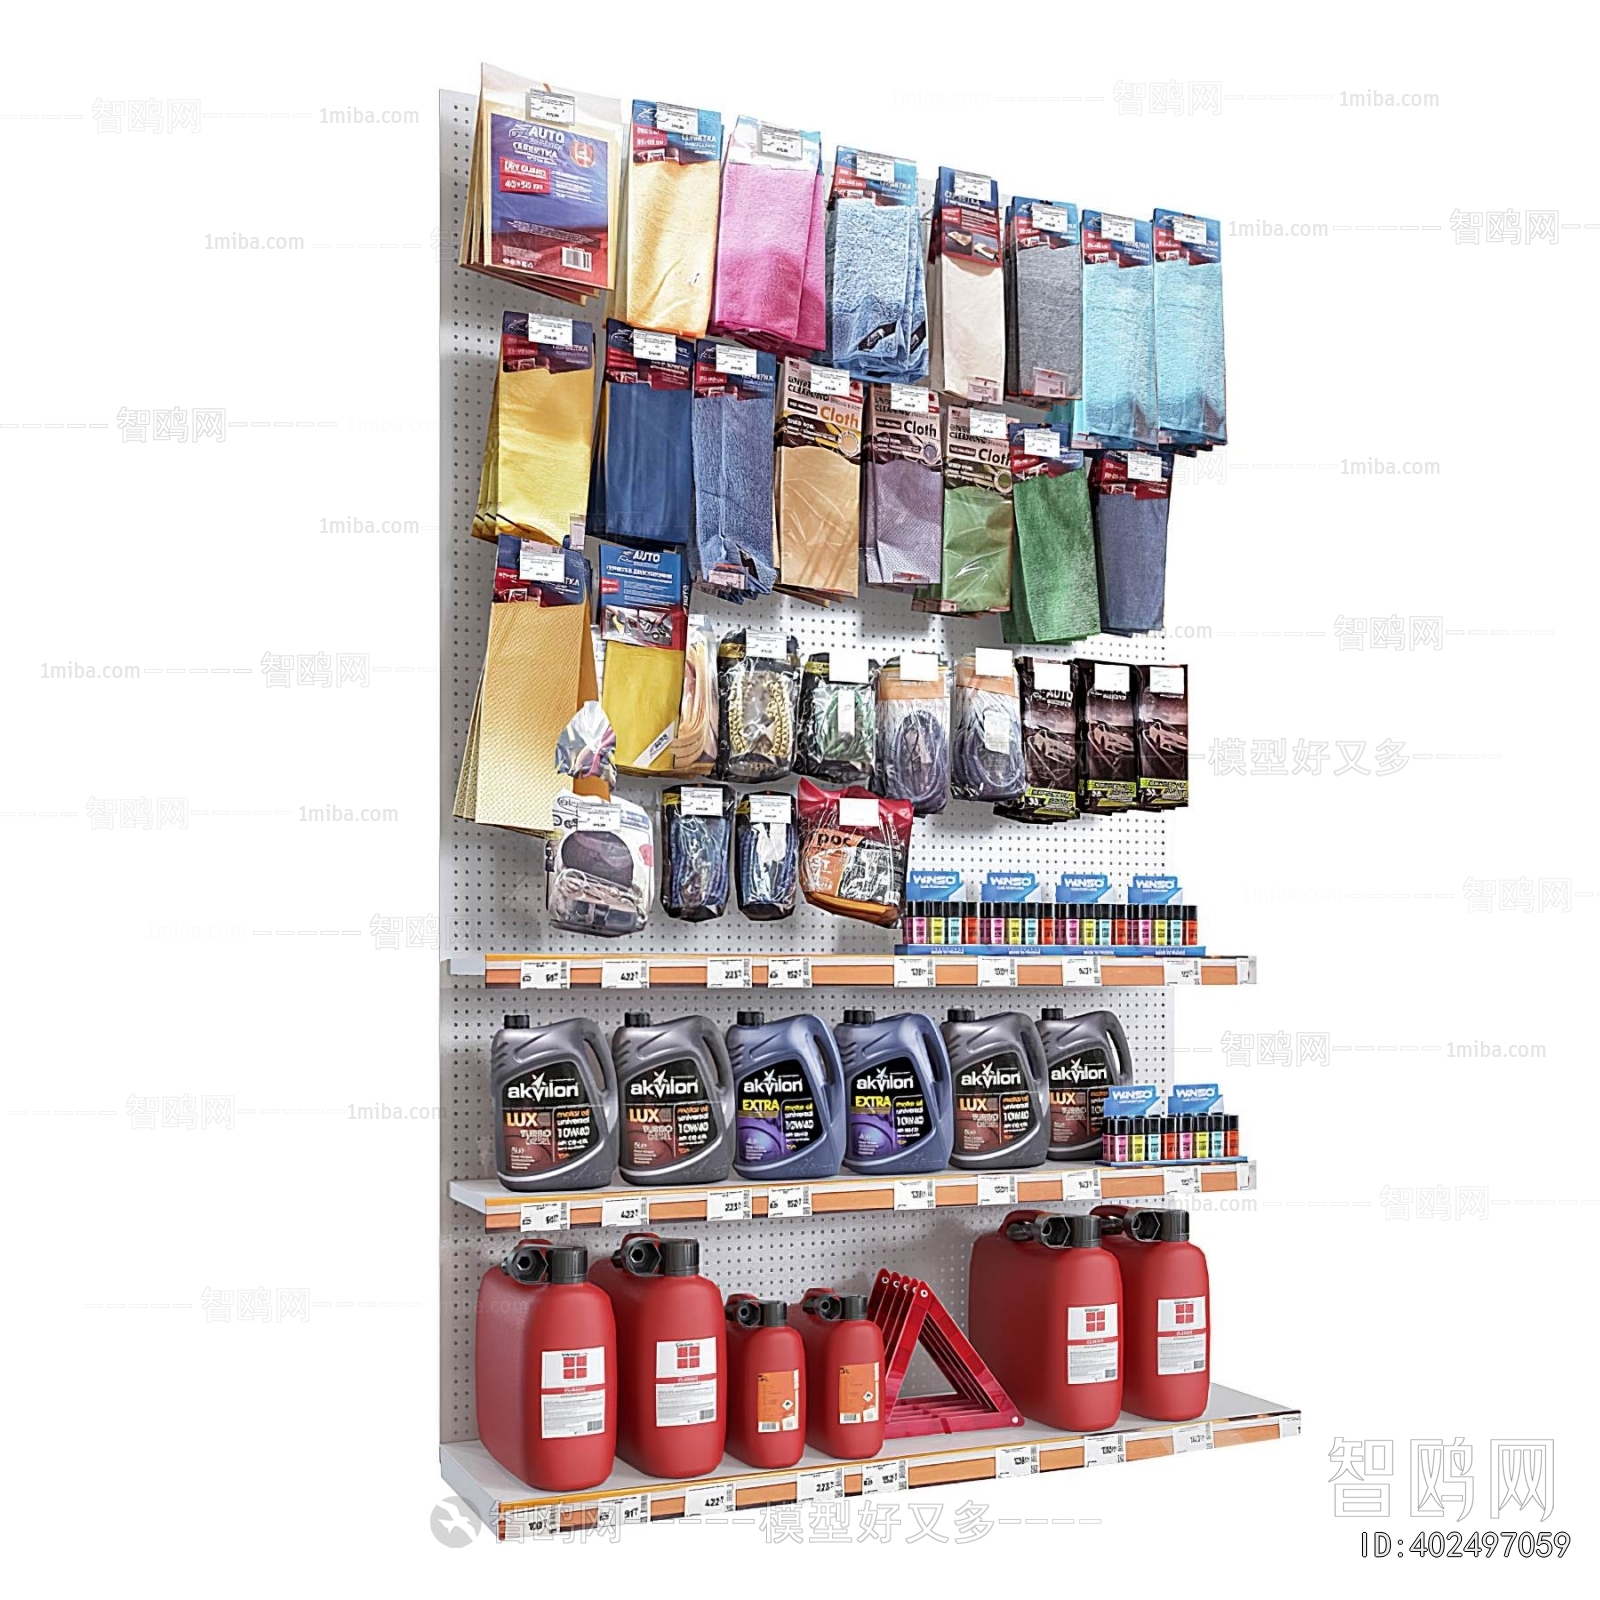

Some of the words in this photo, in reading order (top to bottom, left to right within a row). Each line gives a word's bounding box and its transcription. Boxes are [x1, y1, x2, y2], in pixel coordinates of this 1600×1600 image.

[528, 126, 565, 143] AUTO
[820, 405, 859, 429] Cloth
[903, 420, 937, 438] Cloth
[633, 550, 661, 563] AUTO
[912, 874, 956, 886] WINSO
[989, 876, 1032, 887] WINSO
[1064, 877, 1106, 888] WINSO
[1135, 878, 1177, 890] WINSO
[961, 1069, 1021, 1089] akvilon
[1051, 1064, 1107, 1083] akvilon
[507, 1079, 580, 1102] akvilon
[630, 1078, 699, 1099] akvilon
[744, 1077, 803, 1096] akvilon
[856, 1074, 914, 1094] akvilon
[1050, 1092, 1076, 1105] LUX
[1112, 1088, 1153, 1100] WINSO
[1176, 1086, 1215, 1098] WINSO
[742, 1099, 780, 1112] EXTRA
[855, 1096, 891, 1108] EXTRA
[959, 1097, 987, 1111] LUX
[506, 1112, 539, 1127] LUX
[629, 1108, 660, 1123] LUX
